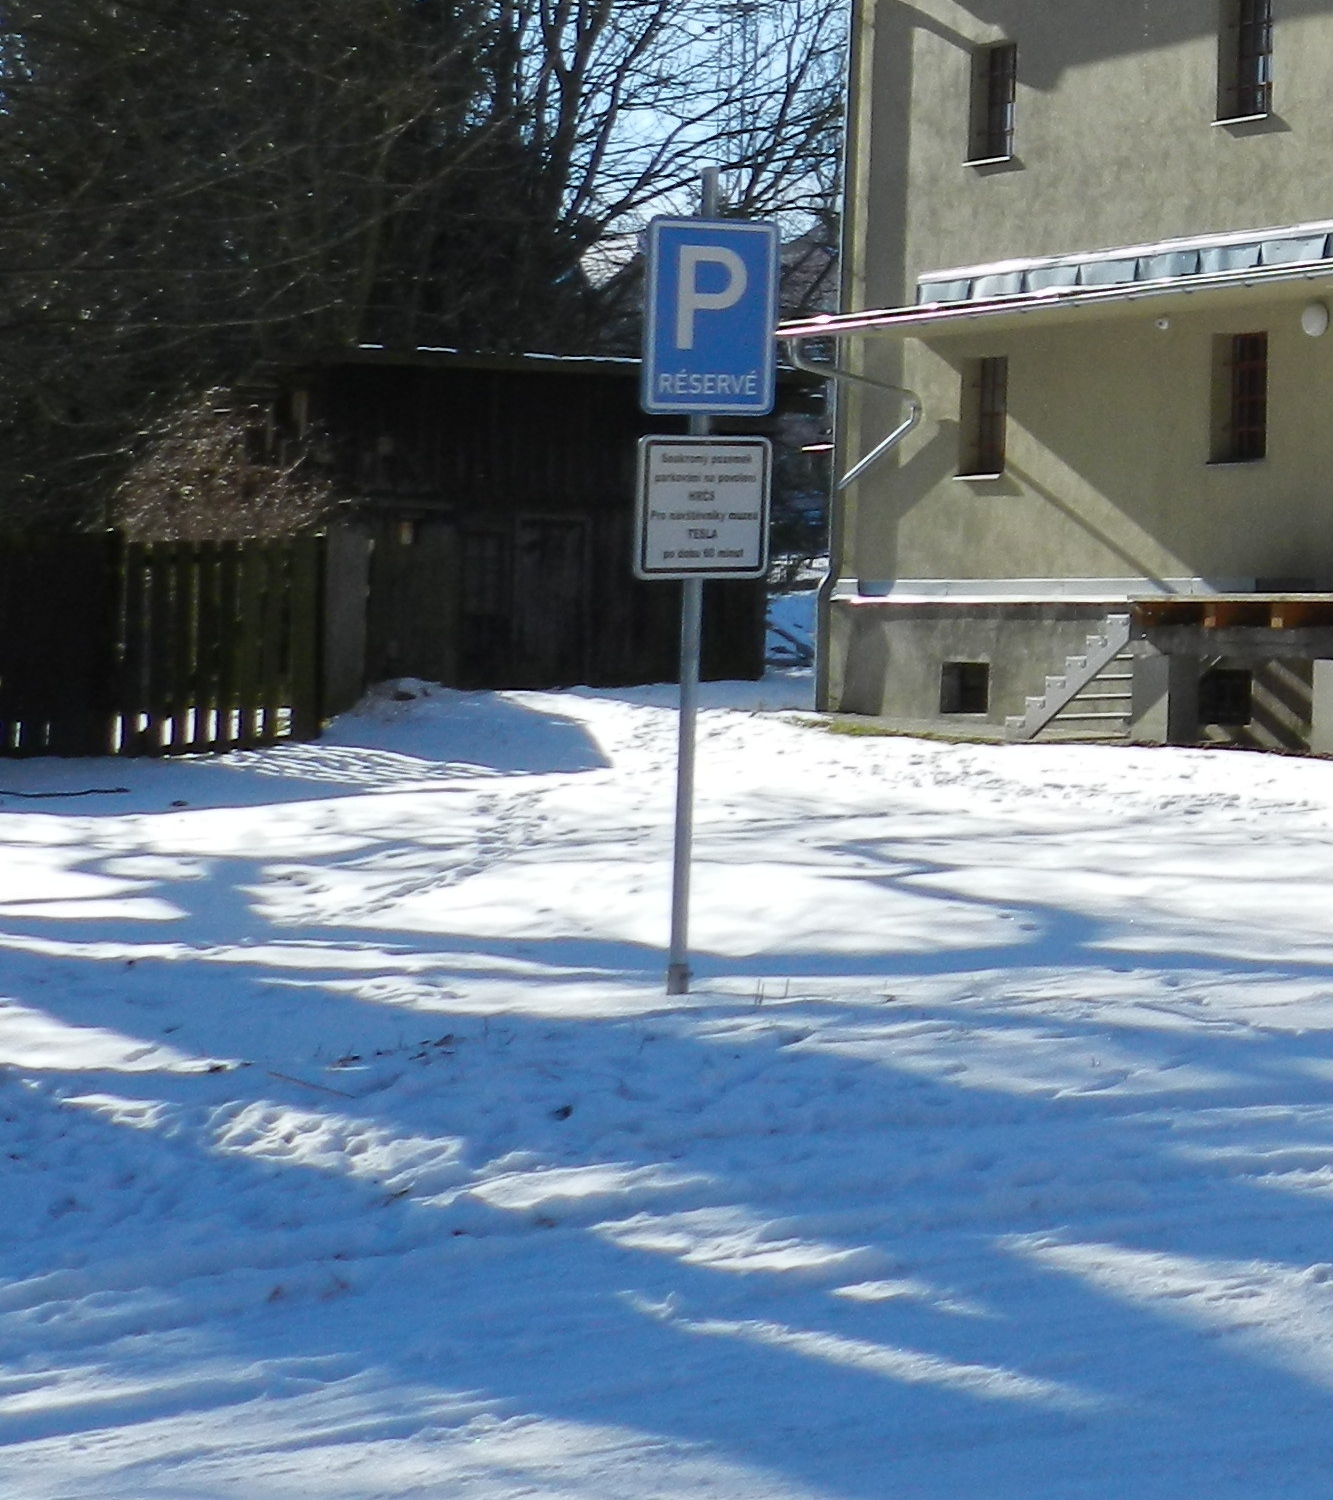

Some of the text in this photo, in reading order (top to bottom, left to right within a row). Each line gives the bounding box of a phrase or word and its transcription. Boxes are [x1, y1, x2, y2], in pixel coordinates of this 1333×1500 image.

[676, 244, 748, 351] P
[658, 369, 758, 396] RÉSERVÉ
[688, 528, 718, 539] TESLA
